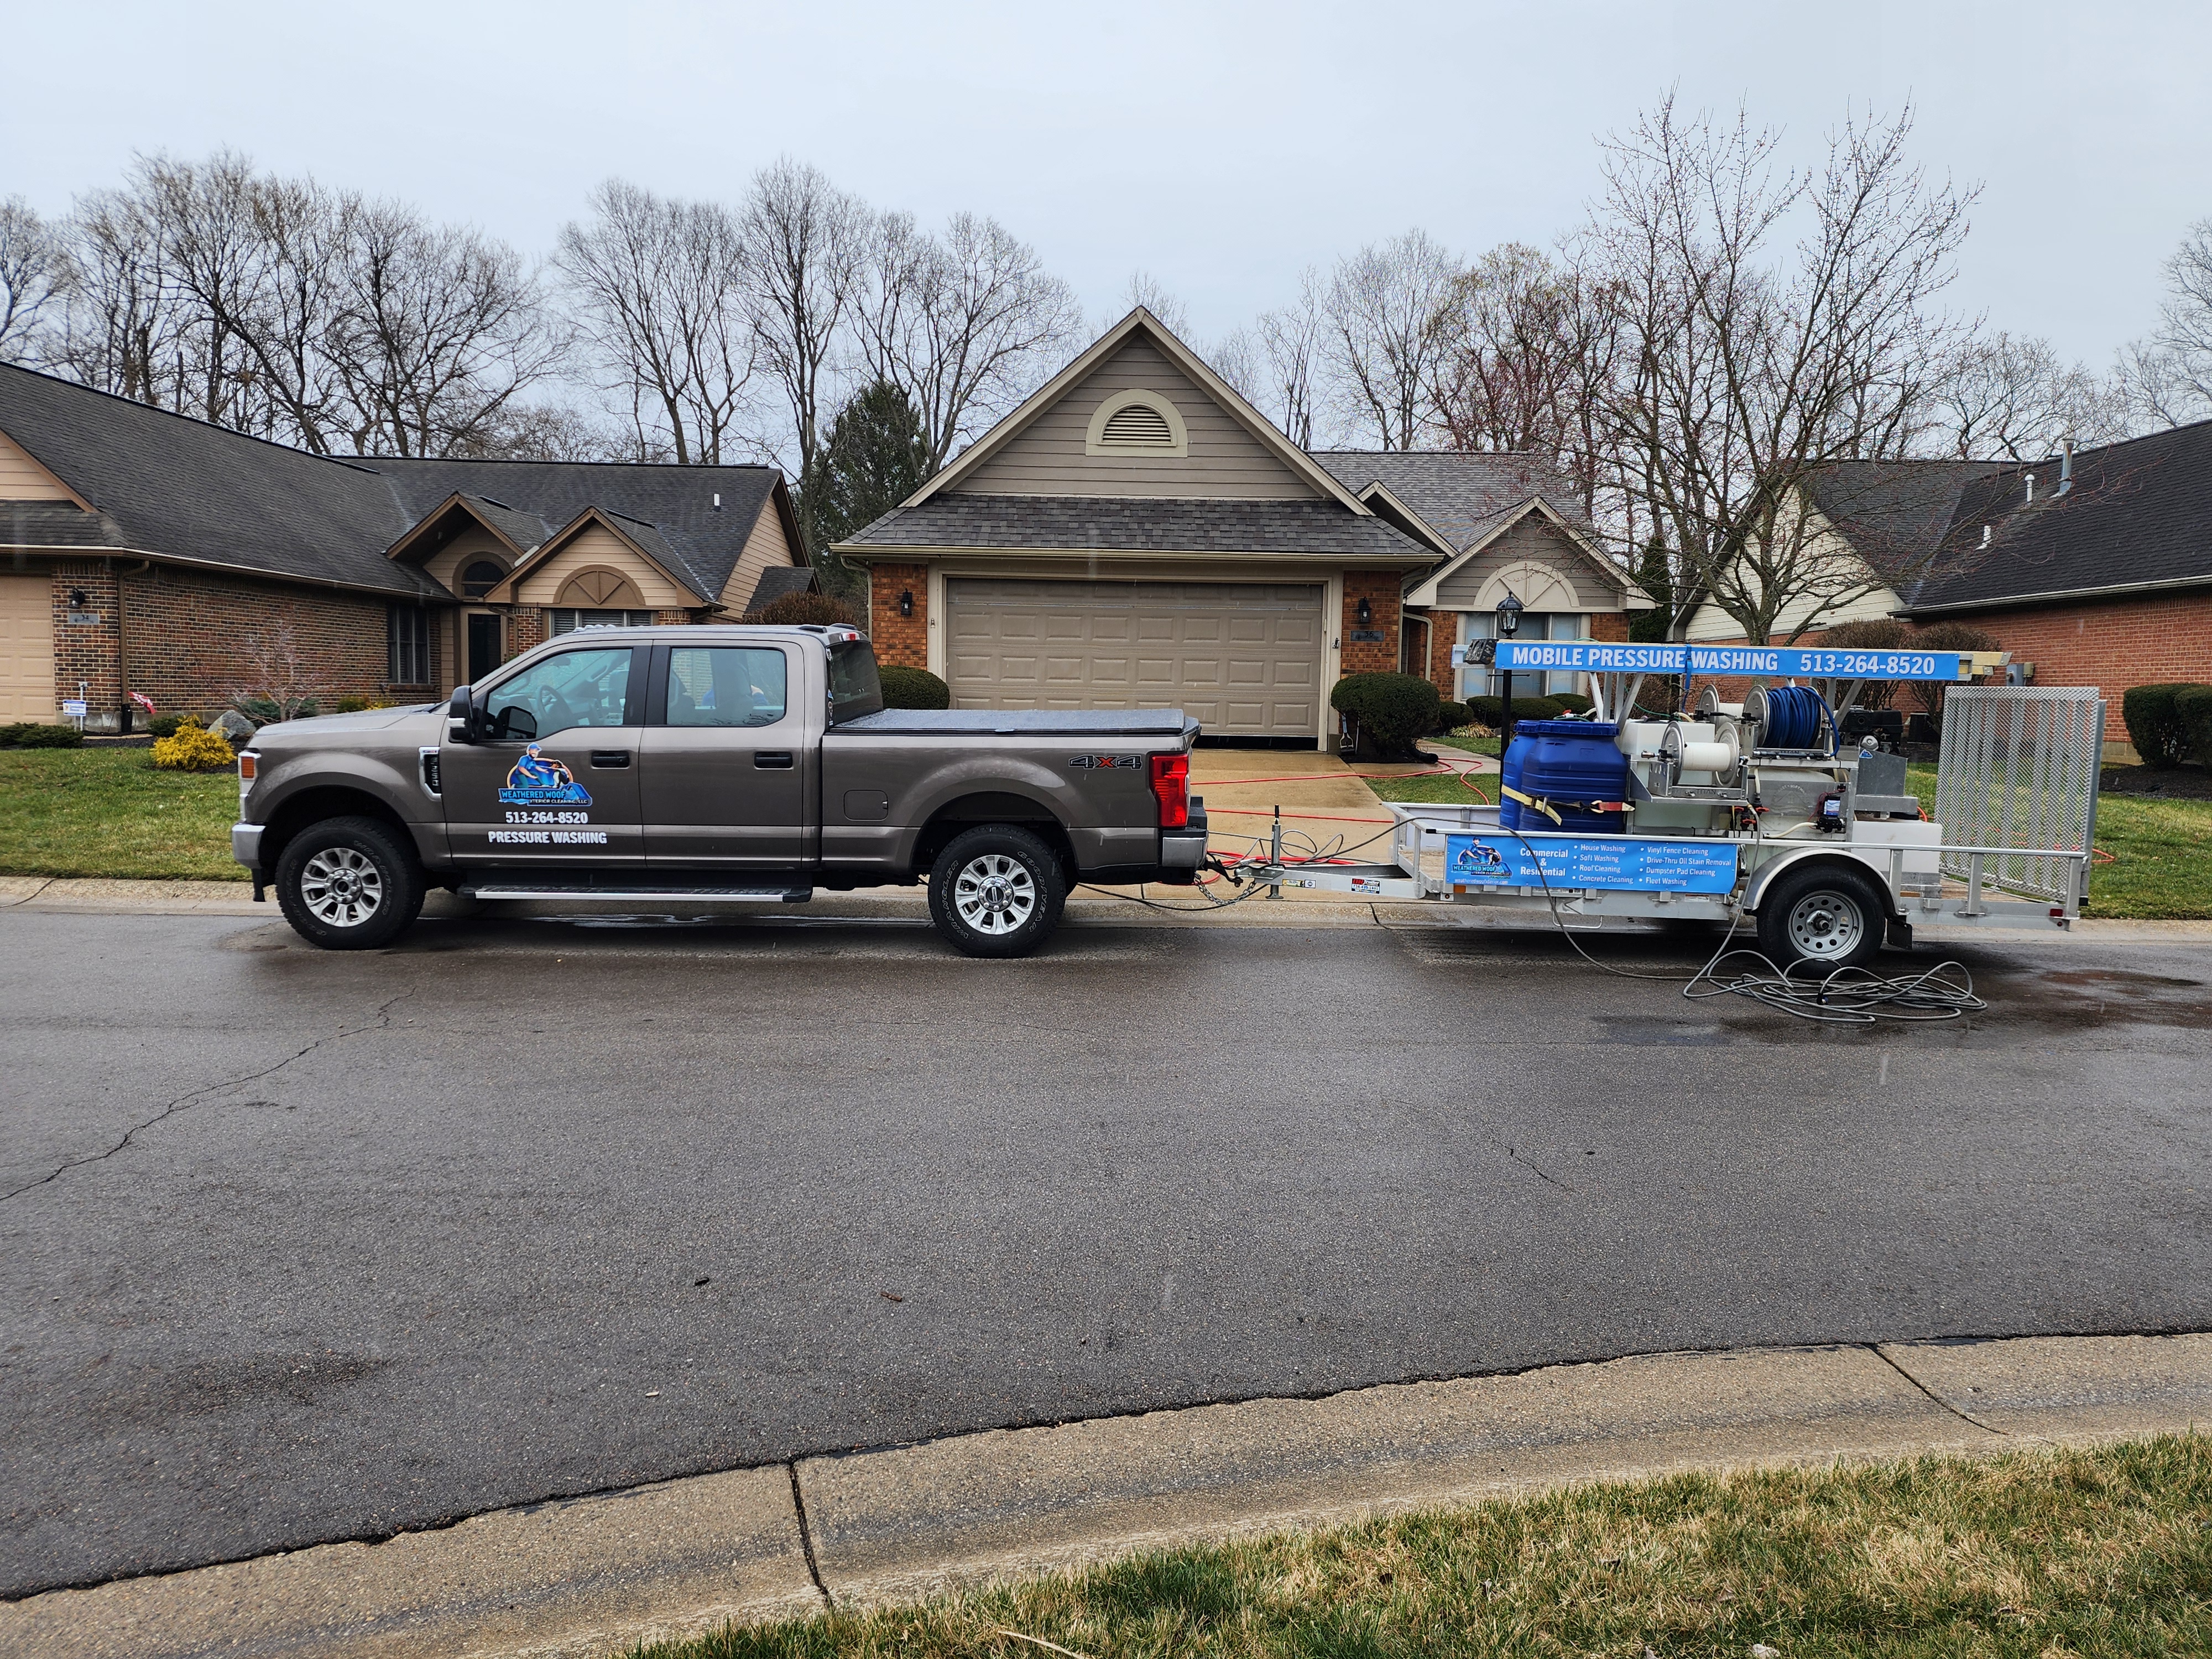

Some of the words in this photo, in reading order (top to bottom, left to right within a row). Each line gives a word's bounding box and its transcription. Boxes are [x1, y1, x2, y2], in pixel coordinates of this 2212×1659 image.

[1512, 647, 1583, 666] MOBILE
[1588, 648, 1686, 669] PRESSURE
[1691, 651, 1778, 671] WASHING
[1799, 654, 1936, 675] 513-264-8520
[505, 811, 588, 824] 513-264-8520
[488, 831, 550, 843] PRESSURE
[551, 831, 608, 844] WASHING
[1520, 848, 1568, 858] Commercial
[1580, 844, 1600, 852] House
[1601, 845, 1626, 853] Washing
[1647, 846, 1662, 855] Vinyl
[1682, 847, 1708, 856] Cleaning
[1540, 858, 1547, 866] &
[1594, 855, 1619, 863] Washing
[1594, 865, 1621, 874] Cleaning
[1646, 867, 1676, 876] Dumpster
[1689, 868, 1715, 877] Cleaning
[1607, 875, 1634, 884] Cleaning
[1662, 878, 1687, 886] Washing
[1018, 851, 1047, 932] GOODYEAR
[942, 860, 968, 939] WRANGLER
